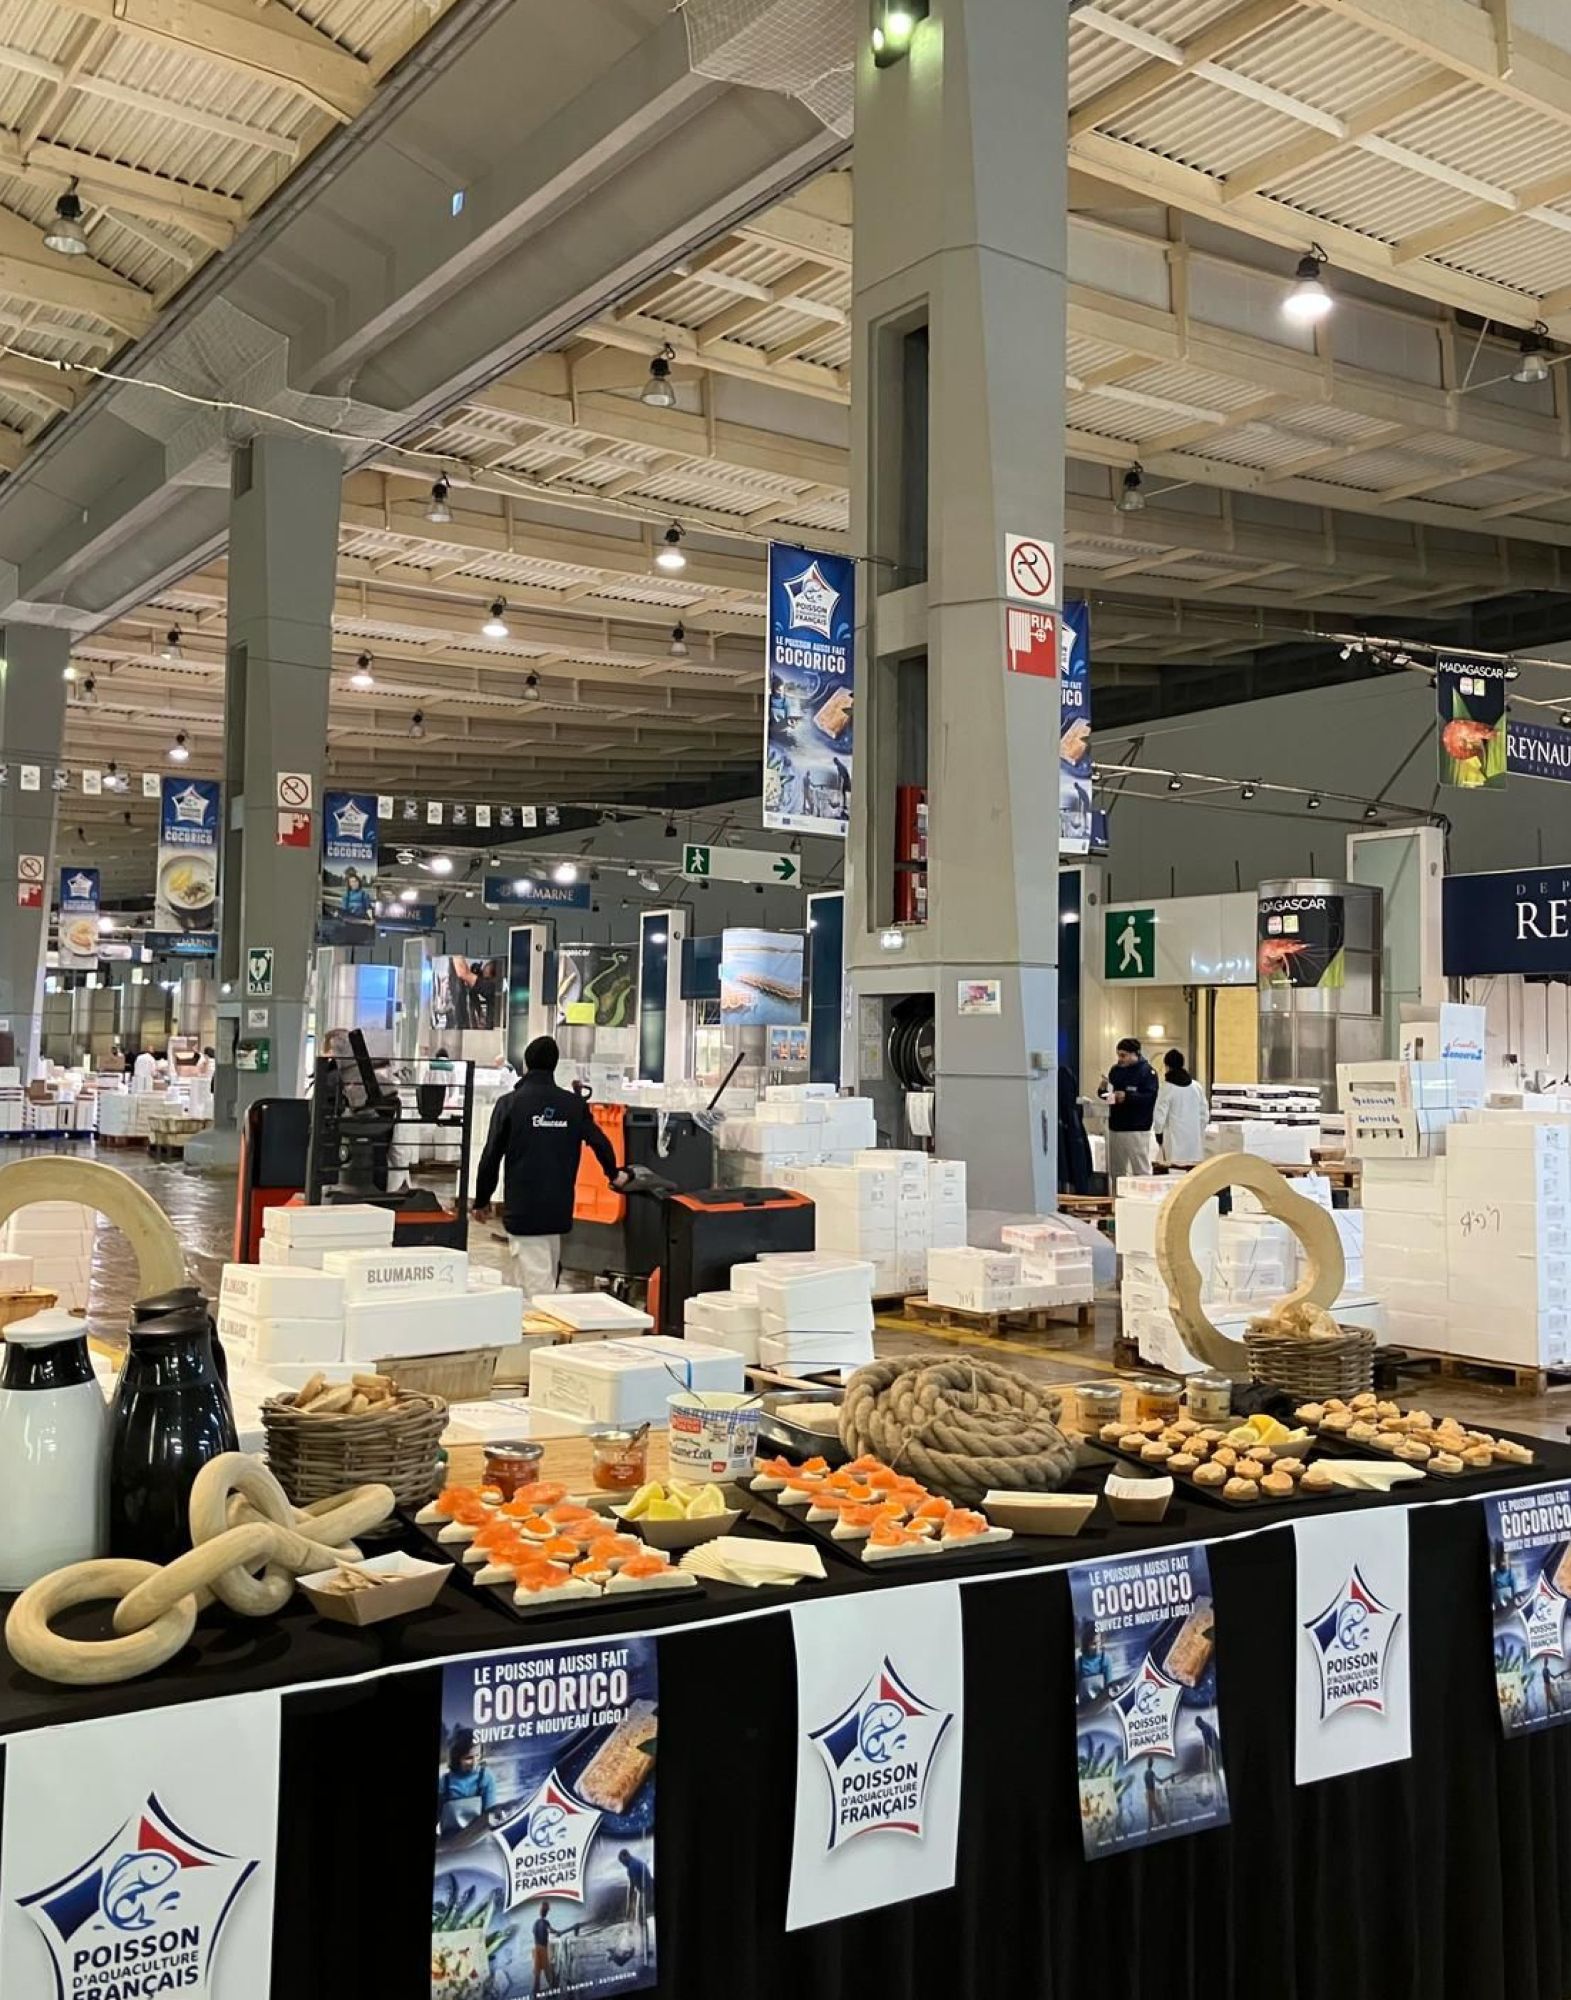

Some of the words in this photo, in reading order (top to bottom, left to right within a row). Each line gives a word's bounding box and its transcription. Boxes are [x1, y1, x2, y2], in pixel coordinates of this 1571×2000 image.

[1031, 614, 1053, 631] RIA
[775, 645, 846, 674] COCORICO
[1439, 661, 1504, 680] MADAGASCAR
[1259, 898, 1327, 914] DAGASCAR
[1515, 899, 1571, 940] RE
[249, 982, 271, 993] DAE
[367, 1265, 434, 1284] BLUMARIS
[1501, 1504, 1571, 1539] COCORICO
[1089, 1571, 1102, 1586] LE
[1103, 1564, 1142, 1584] POISSON
[1145, 1558, 1170, 1577] AUSSI
[1171, 1555, 1189, 1572] FAIT
[1092, 1571, 1193, 1618] COCORICO
[474, 1667, 491, 1686] LE
[495, 1658, 554, 1683] POISSON
[558, 1652, 597, 1675] AUSSI
[601, 1649, 629, 1669] FAIT
[1327, 1651, 1378, 1675] POISSON
[473, 1668, 628, 1725] COCORICO
[1327, 1676, 1379, 1700] FRANÇAIS
[472, 1724, 515, 1744] SUIVEZ
[518, 1721, 533, 1738] CE
[536, 1712, 590, 1735] NOUVEAU
[593, 1708, 621, 1727] LOGO
[1129, 1713, 1167, 1731] POISSON
[842, 1761, 918, 1794] POISSON
[841, 1781, 918, 1807] D'AQUACULTURE
[841, 1793, 918, 1825] FRANÇAIS
[515, 1846, 577, 1870] POISSON
[515, 1869, 577, 1892] FRANÇAIS
[73, 1925, 199, 1973] POISSON
[73, 1950, 199, 1989] D'AQUACULTURE
